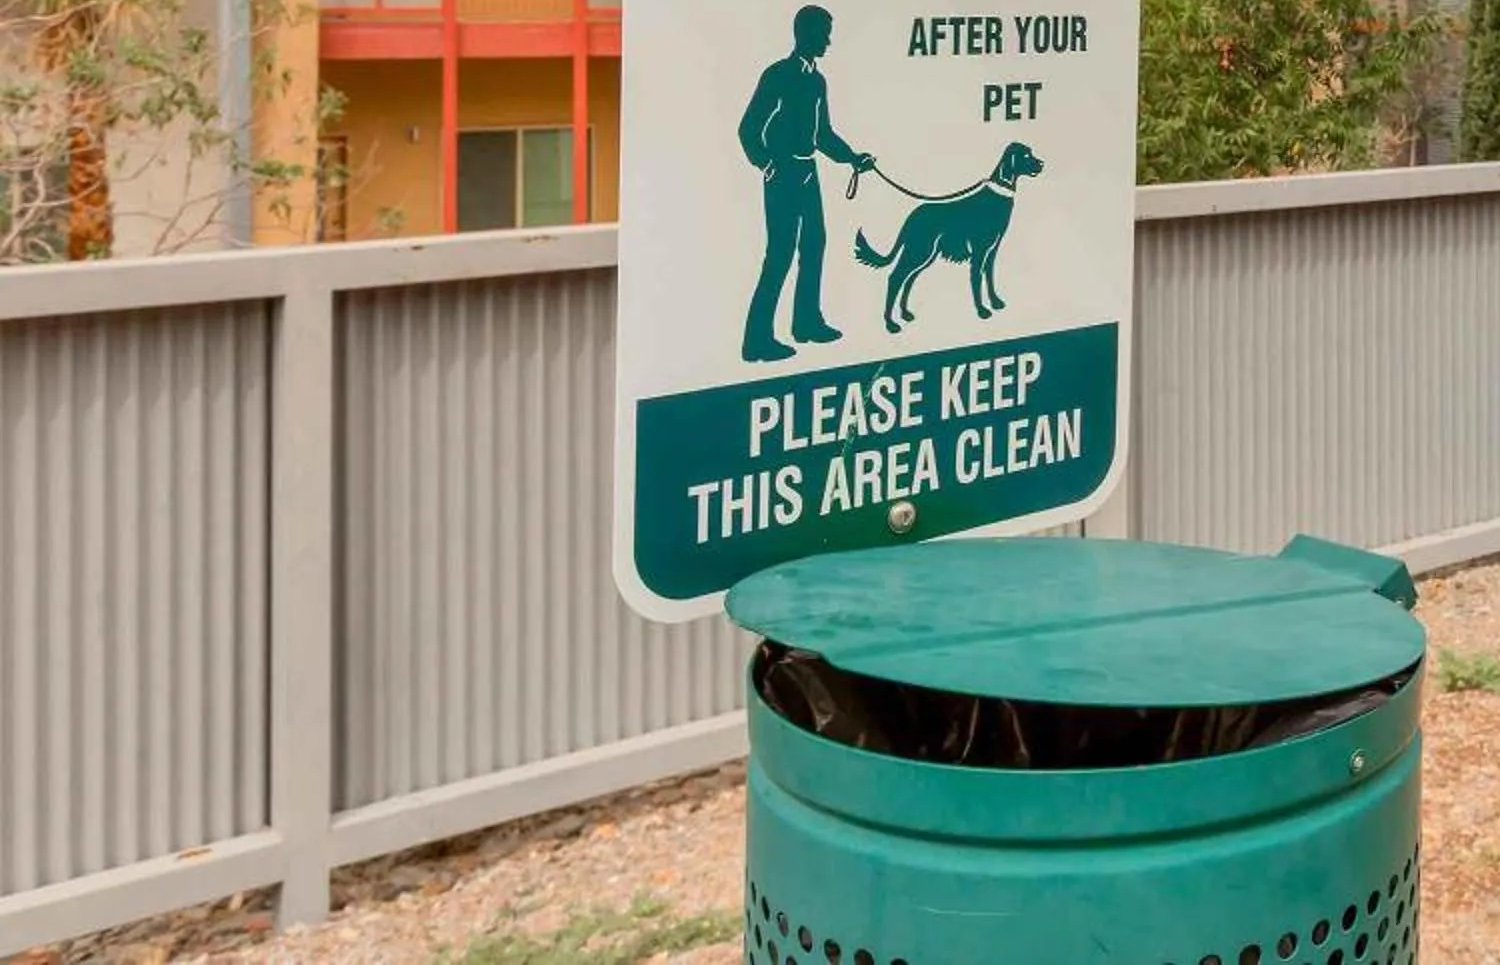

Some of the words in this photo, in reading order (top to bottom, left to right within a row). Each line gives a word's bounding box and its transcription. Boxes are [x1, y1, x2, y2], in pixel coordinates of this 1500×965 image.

[908, 17, 1002, 56] AFTER
[1014, 15, 1087, 53] YOUR
[983, 82, 1042, 122] PET
[749, 371, 924, 458] PLEASE
[940, 351, 1042, 420] KEEP
[688, 465, 803, 544] THIS
[819, 437, 940, 516] AREA
[955, 408, 1082, 484] CLEAN
